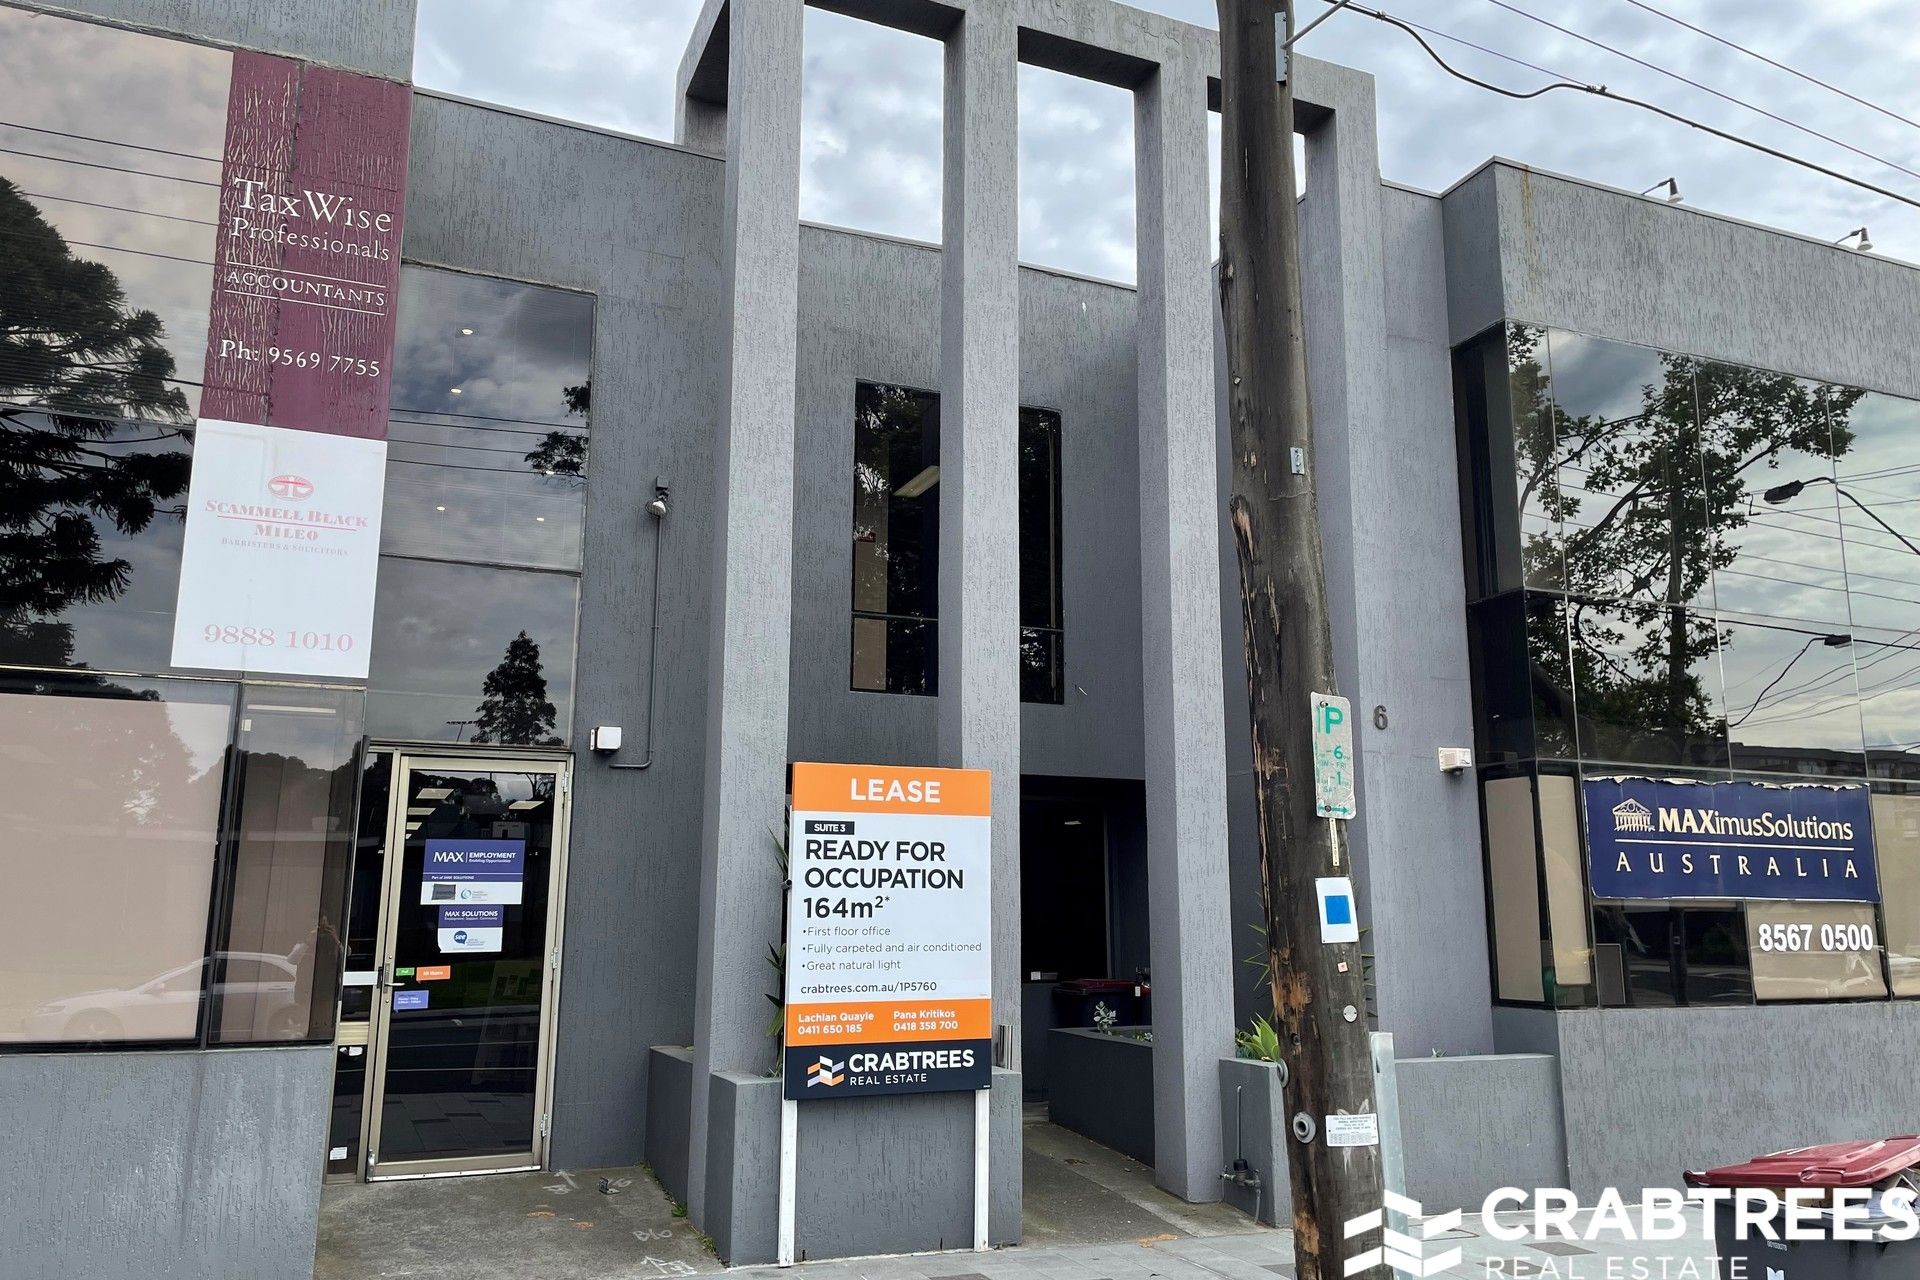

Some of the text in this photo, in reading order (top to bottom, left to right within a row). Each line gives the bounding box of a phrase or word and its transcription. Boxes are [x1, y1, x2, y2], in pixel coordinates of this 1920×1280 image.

[233, 177, 392, 232] TaxWise
[231, 217, 390, 261] Professionals
[226, 271, 385, 306] ACCOUNTANTS
[219, 339, 380, 378] Ph: 9569 7755
[205, 499, 369, 528] SCAMMELL BLACK
[253, 524, 319, 541] MILEO
[204, 623, 353, 652] 9888 1010
[1374, 704, 1388, 730] 6
[850, 777, 942, 804] LEASE
[813, 823, 846, 833] SUITE 3
[433, 851, 465, 863] MAX
[805, 839, 946, 862] READY FOR
[1616, 851, 1859, 879] AUSTRALIA
[804, 867, 964, 889] OCCUPATION
[834, 926, 859, 936] floor
[861, 926, 891, 936] office
[1757, 923, 1874, 952] 8567 0500
[835, 943, 882, 955] carpeted
[885, 942, 905, 952] and
[907, 942, 920, 952] air
[923, 942, 982, 952] conditioned
[839, 960, 875, 970] natural
[878, 960, 902, 972] light
[800, 981, 938, 995] crabtrees.com.au/1P5760
[798, 1011, 875, 1023] Lachlan Quayle
[893, 1009, 956, 1020] Pana Kritikos
[797, 1023, 863, 1035] 0411 650 185
[893, 1020, 959, 1032] 0418 358 700
[849, 1048, 975, 1073] CRABTREES
[850, 1073, 928, 1086] REAL ESTATE
